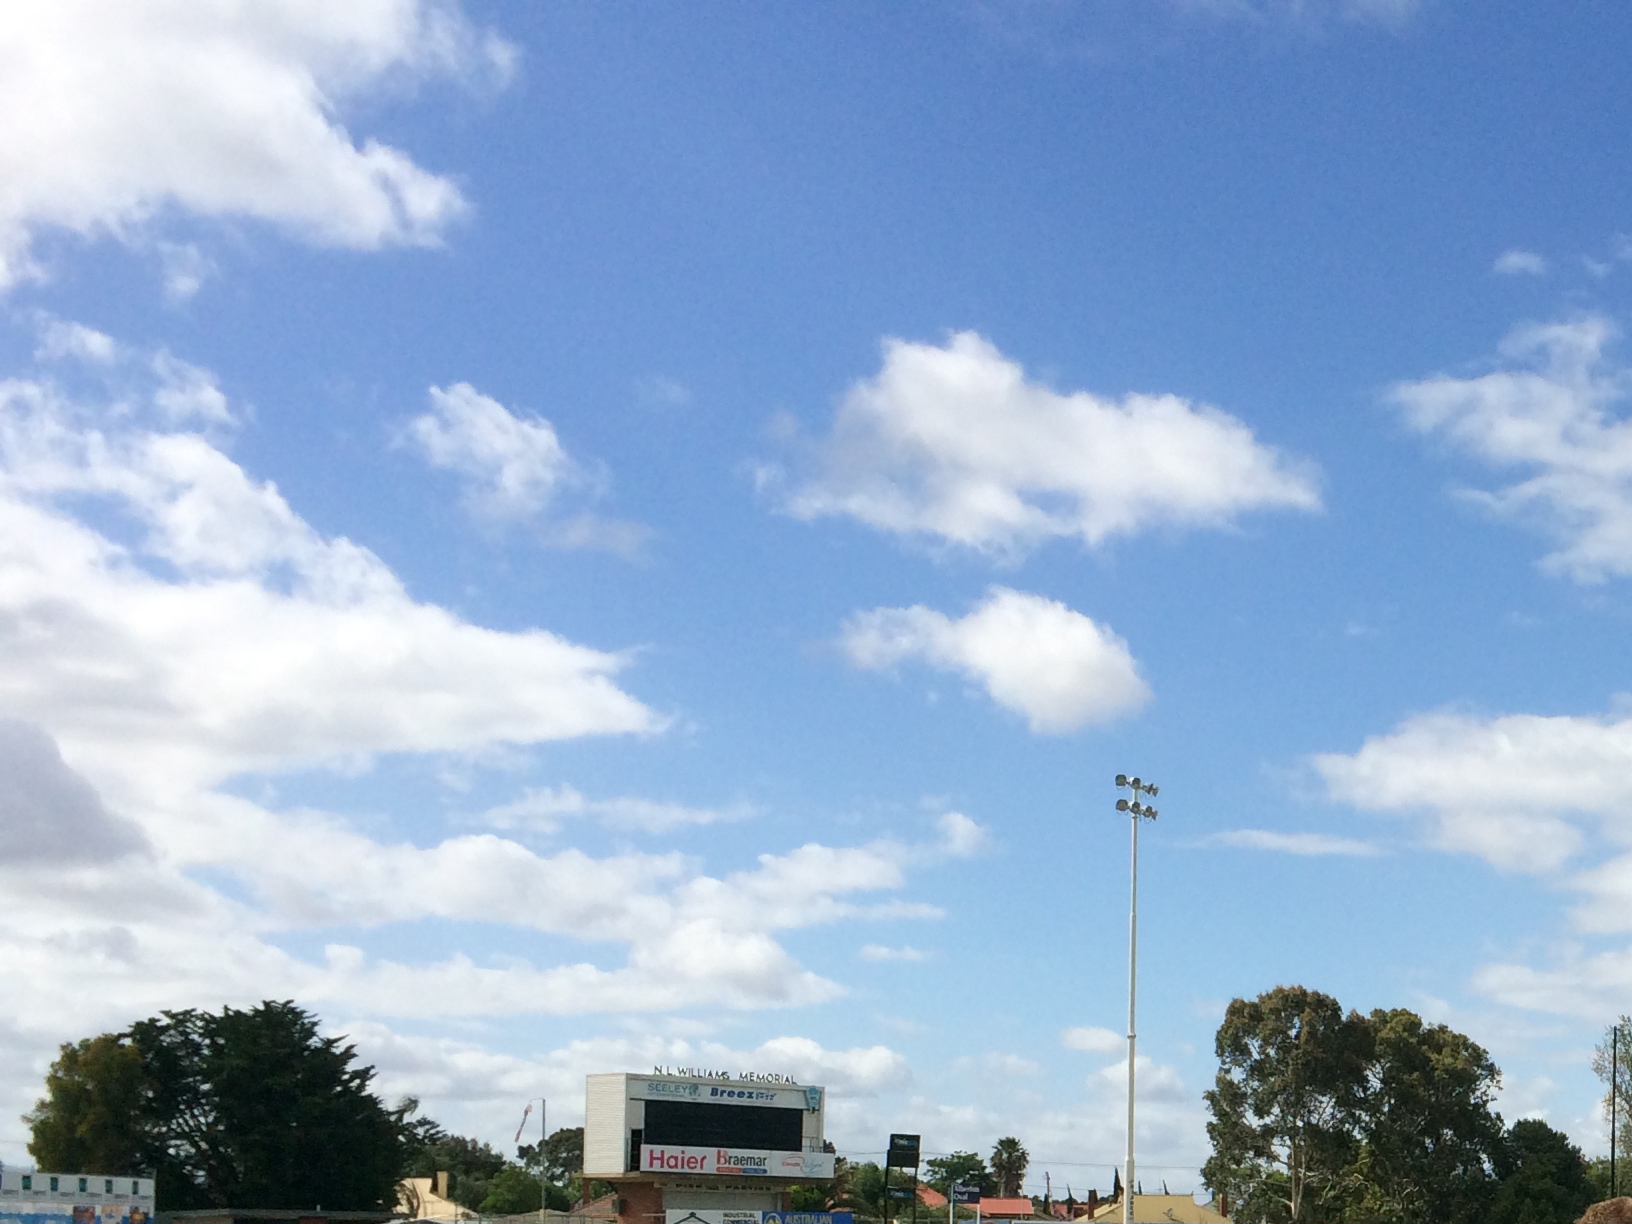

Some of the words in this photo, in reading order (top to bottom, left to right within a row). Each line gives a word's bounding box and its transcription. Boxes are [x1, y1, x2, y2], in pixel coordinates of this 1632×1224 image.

[678, 1067, 730, 1080] WILLIAMS
[739, 1072, 797, 1085] MEMORIAL
[648, 1084, 688, 1093] SEELEY
[649, 1150, 707, 1170] Haier
[785, 1215, 832, 1224] AUSTRALIAN
